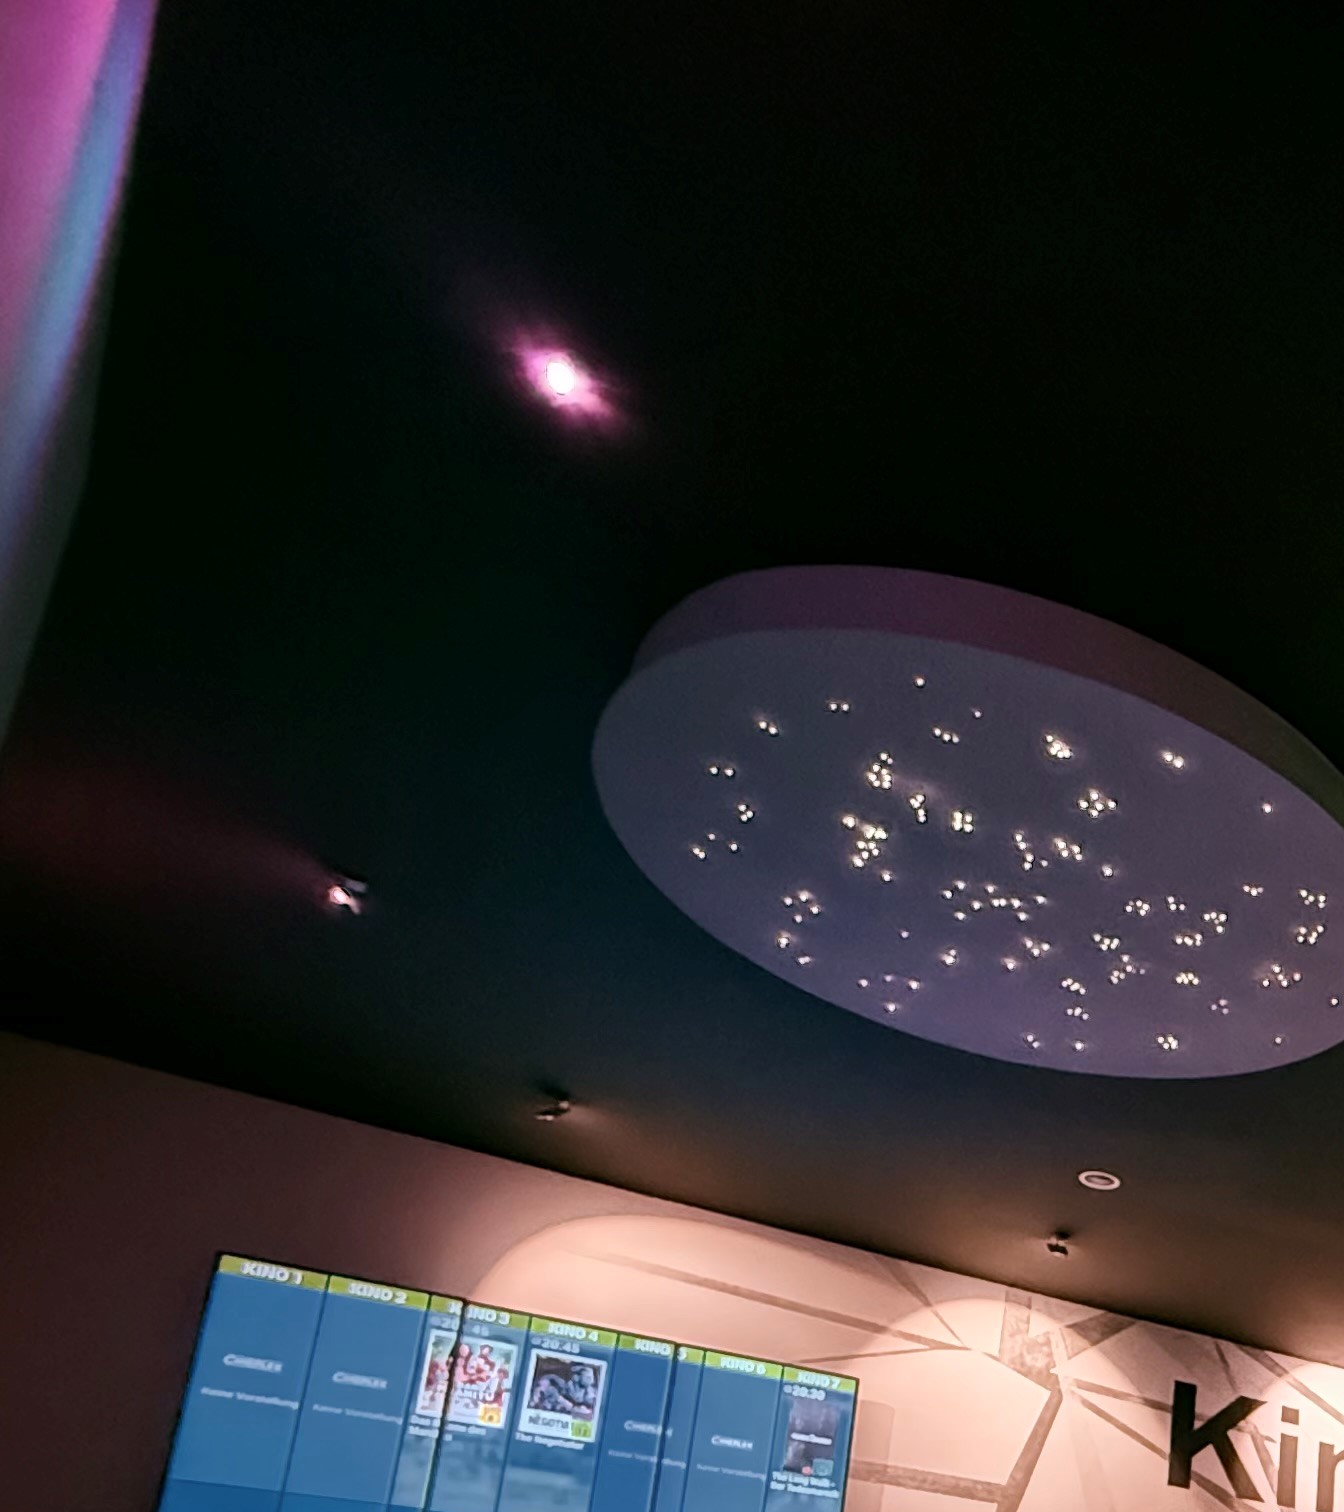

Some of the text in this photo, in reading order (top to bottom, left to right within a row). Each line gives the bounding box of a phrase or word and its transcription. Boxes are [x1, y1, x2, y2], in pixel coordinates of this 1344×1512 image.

[240, 1261, 303, 1286] KINO 1
[348, 1283, 407, 1305] KINO 2
[499, 1312, 510, 1326] 3
[548, 1323, 599, 1342] KINO 4
[634, 1339, 671, 1357] KINO
[720, 1356, 754, 1373] KINO
[797, 1371, 841, 1391] KINO 7
